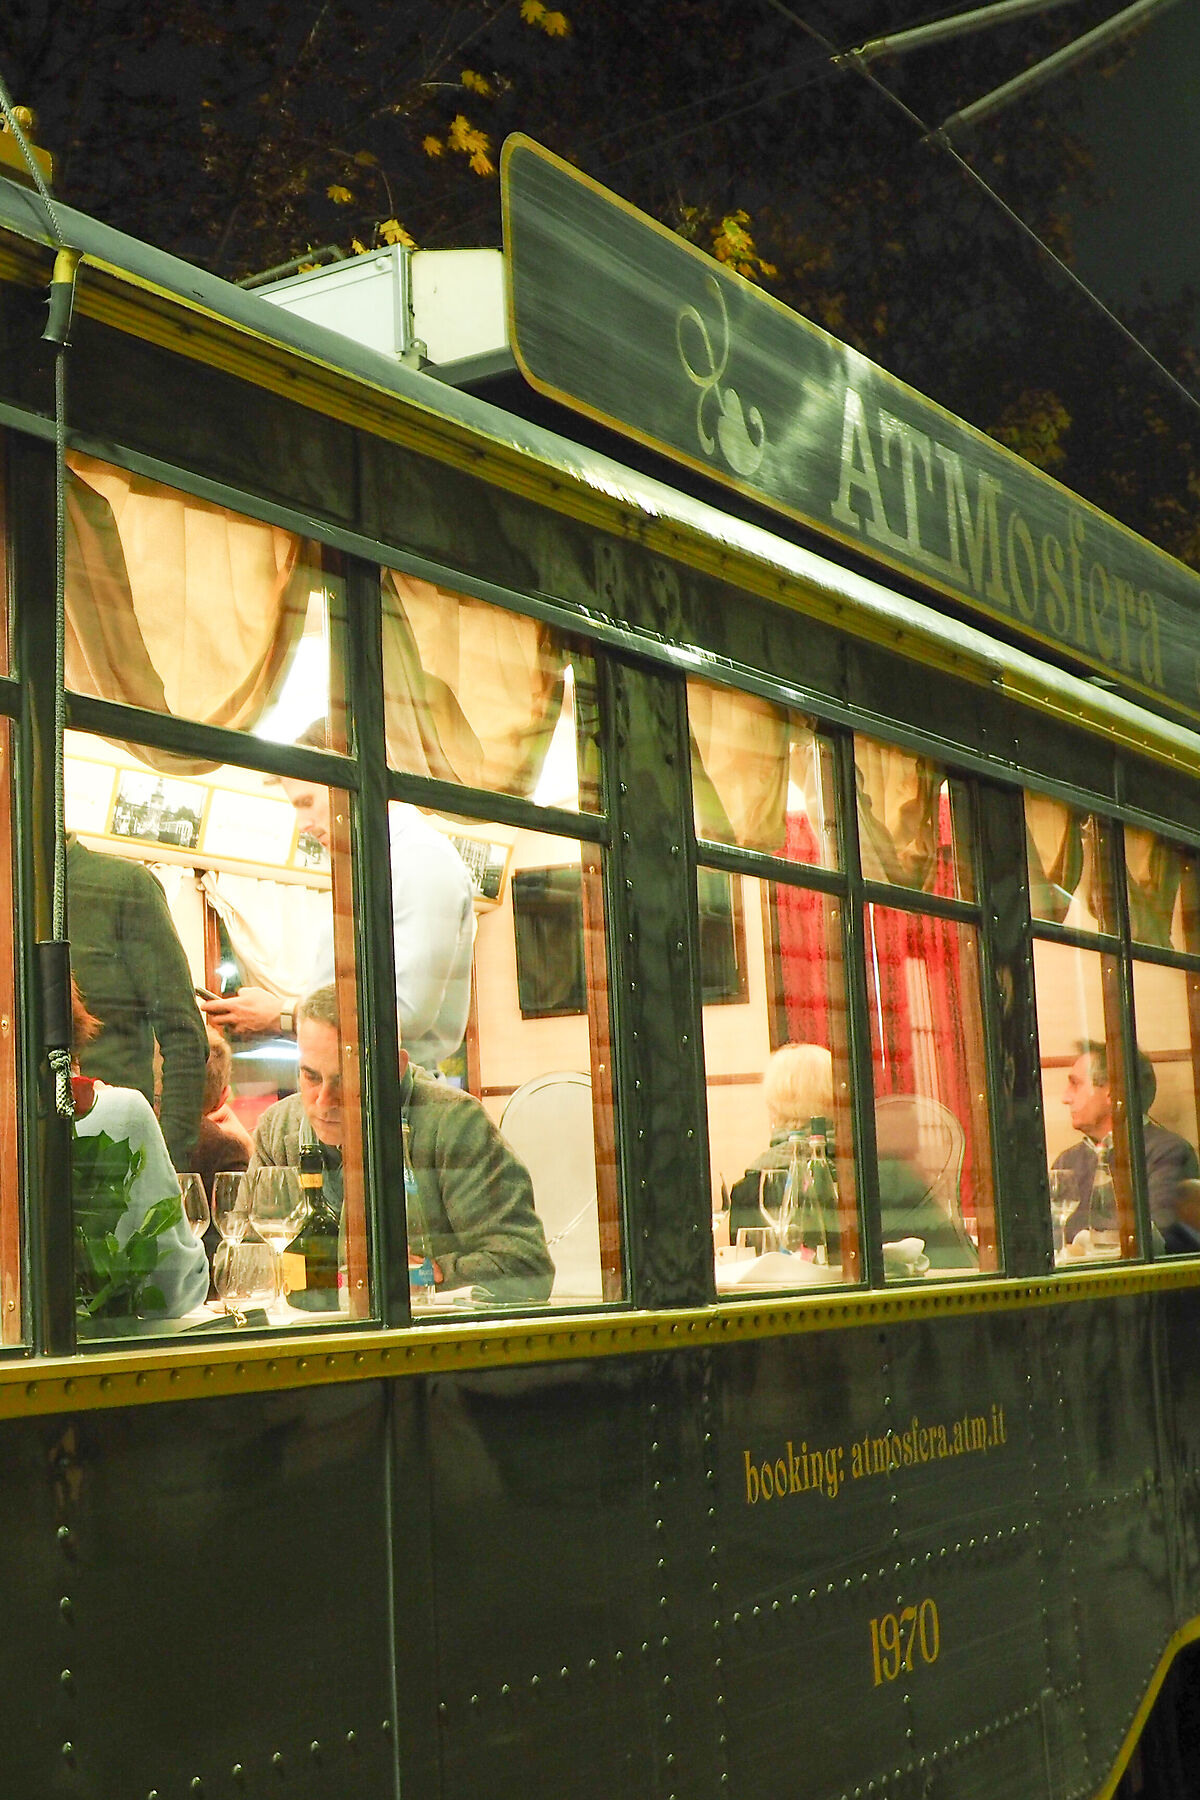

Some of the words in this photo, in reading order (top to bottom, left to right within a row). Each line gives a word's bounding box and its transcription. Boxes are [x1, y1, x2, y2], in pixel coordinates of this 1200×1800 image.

[830, 386, 1165, 689] ATMosfera
[743, 1441, 844, 1504] booking:
[851, 1403, 1007, 1480] atmosfera.atm.it
[869, 1598, 940, 1687] 1970
